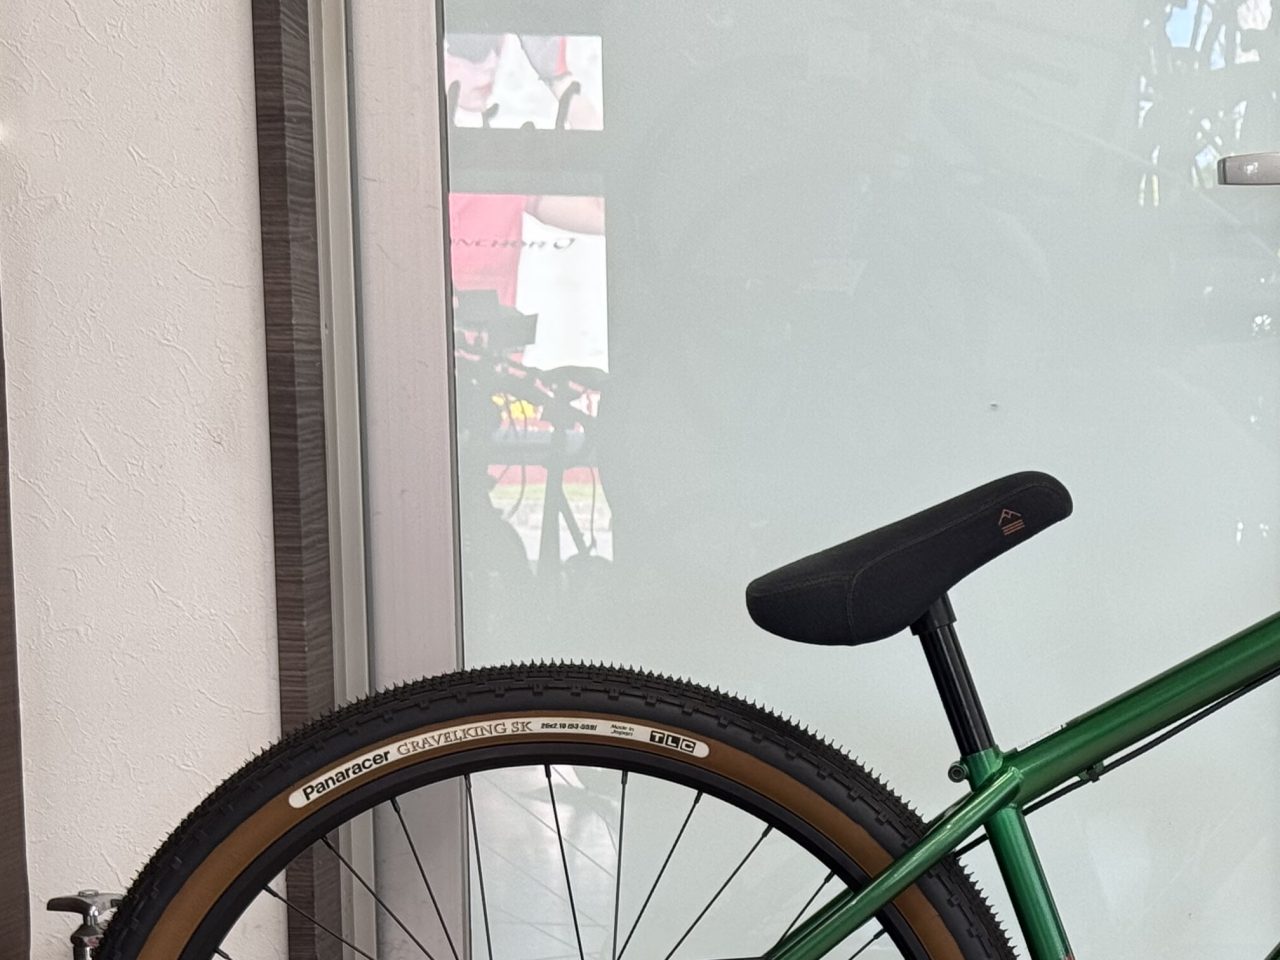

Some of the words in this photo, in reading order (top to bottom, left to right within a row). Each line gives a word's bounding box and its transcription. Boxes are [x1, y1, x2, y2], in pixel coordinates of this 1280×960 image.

[302, 749, 391, 801] Panaracer
[396, 722, 507, 756] GRAVELKING
[511, 720, 533, 732] SK
[650, 730, 697, 753] TLC
